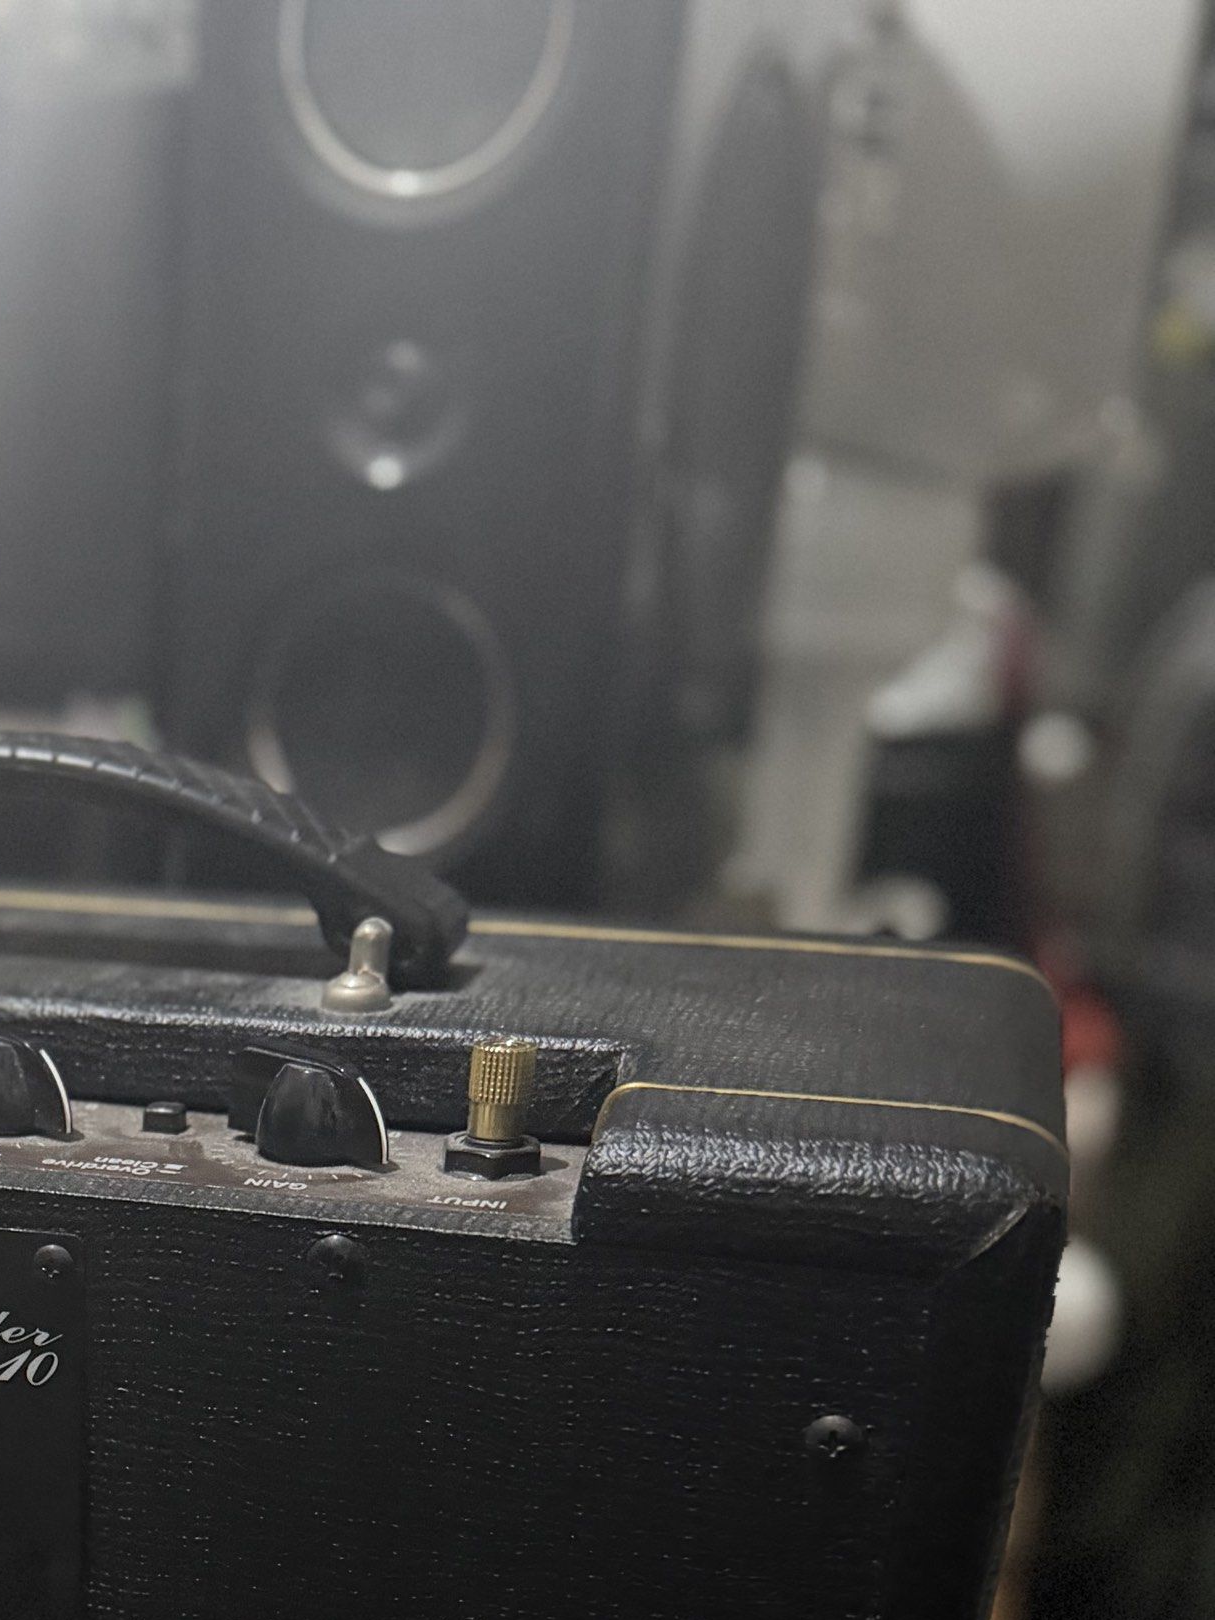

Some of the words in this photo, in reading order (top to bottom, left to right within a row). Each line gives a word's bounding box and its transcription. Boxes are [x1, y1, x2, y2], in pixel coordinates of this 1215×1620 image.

[42, 1158, 151, 1176] Overdrive
[94, 1156, 158, 1170] Clean
[243, 1177, 307, 1190] GAIN
[426, 1195, 508, 1210] INPUT
